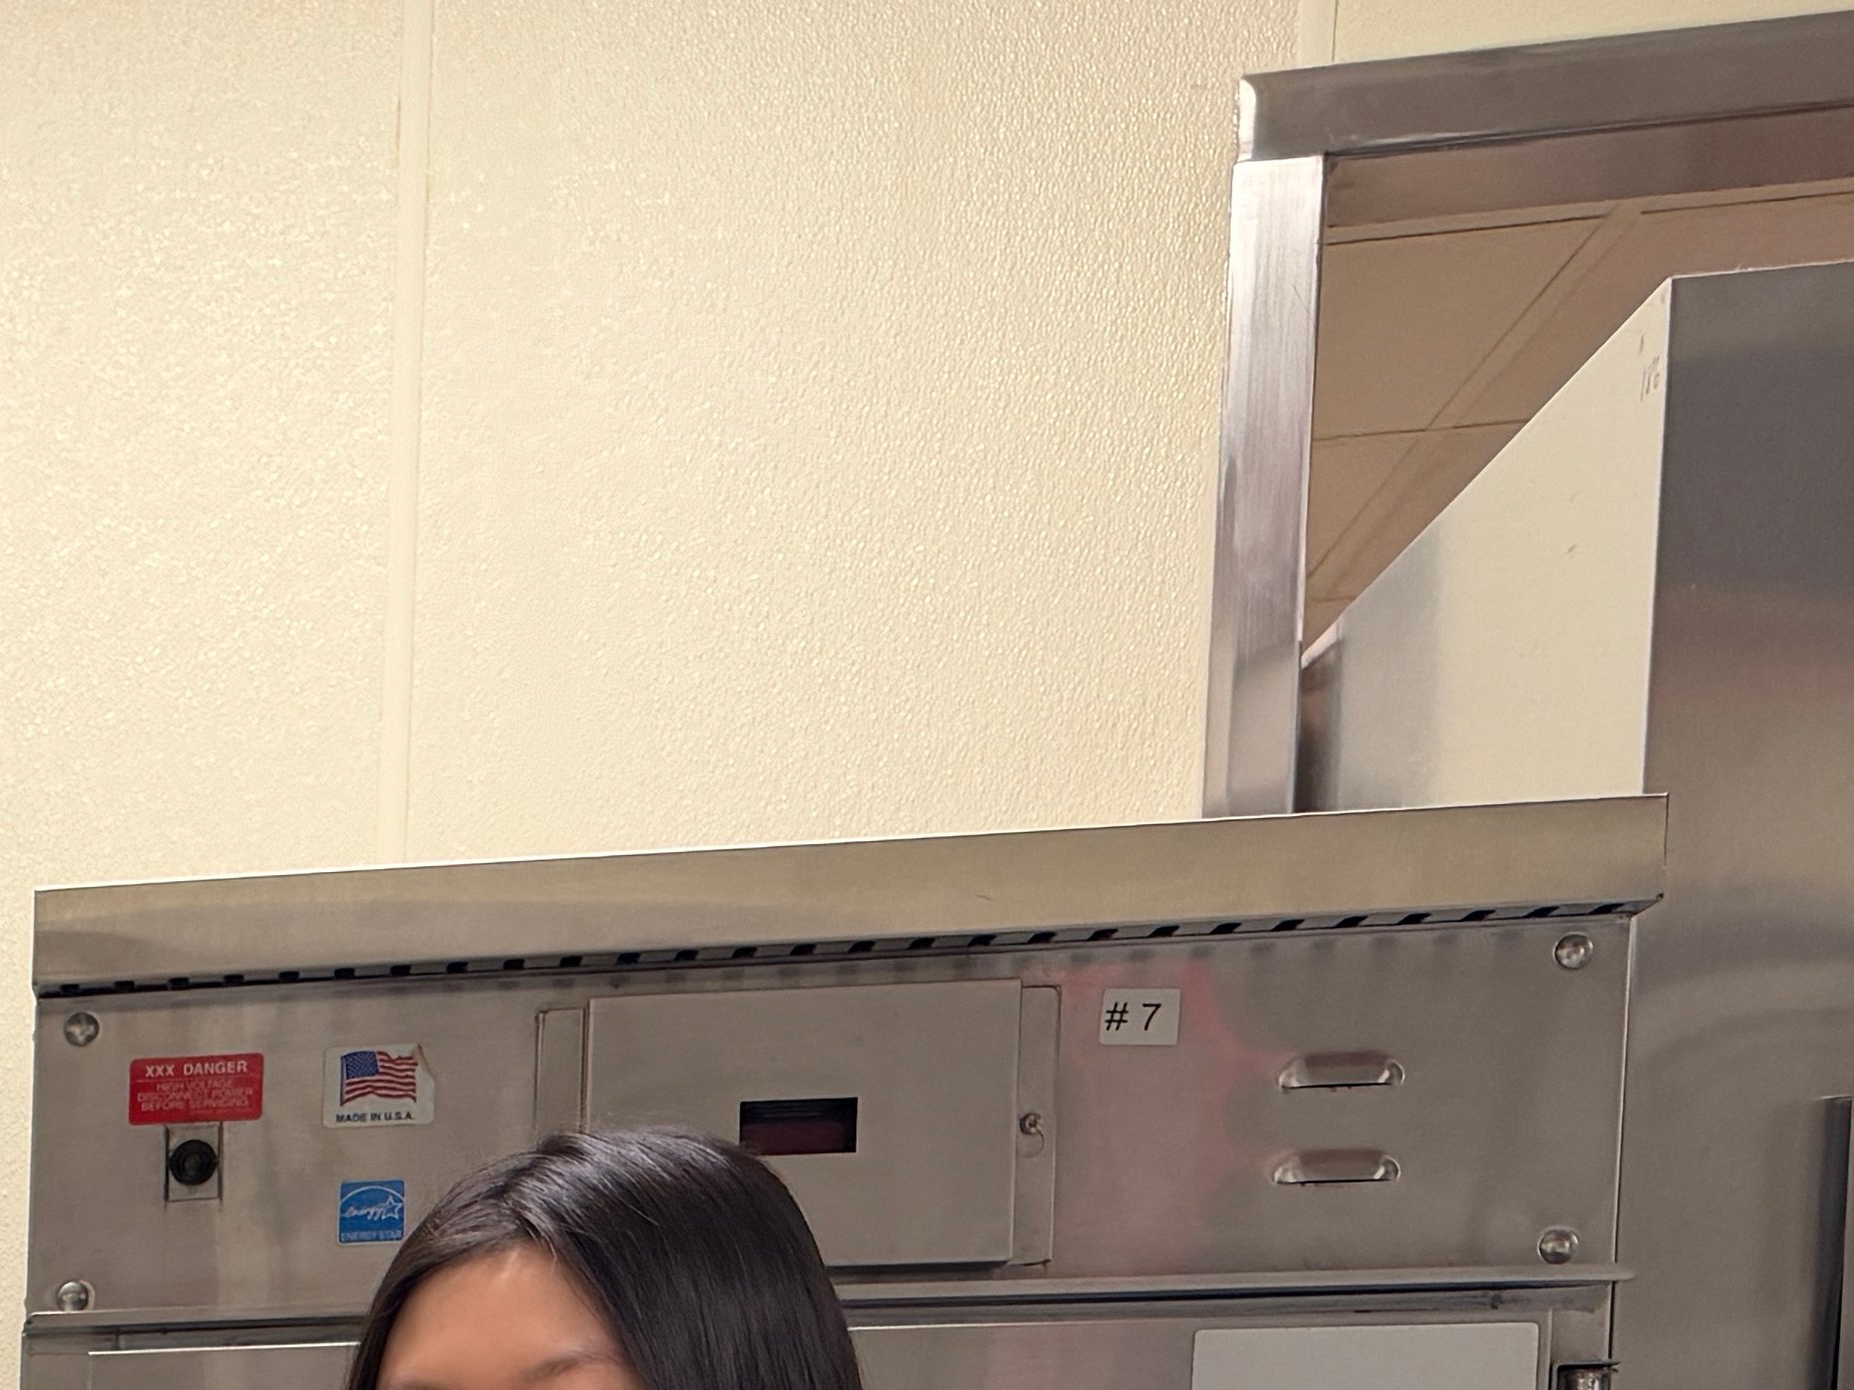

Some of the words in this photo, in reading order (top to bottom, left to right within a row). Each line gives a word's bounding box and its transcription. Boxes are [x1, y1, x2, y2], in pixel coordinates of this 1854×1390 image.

[145, 1064, 175, 1078] XXX
[183, 1060, 248, 1076] DANGER
[336, 1113, 367, 1123] MADE
[370, 1112, 381, 1121] IN
[341, 1231, 376, 1243] ENERGY
